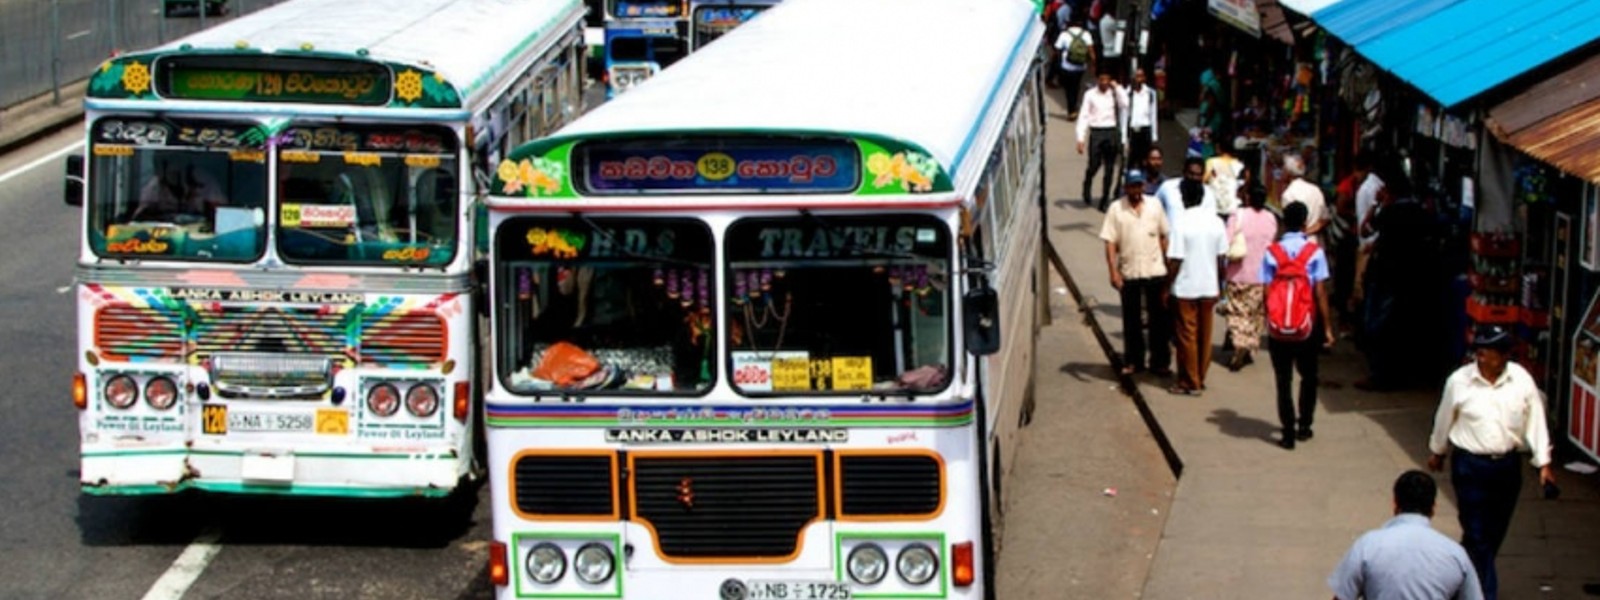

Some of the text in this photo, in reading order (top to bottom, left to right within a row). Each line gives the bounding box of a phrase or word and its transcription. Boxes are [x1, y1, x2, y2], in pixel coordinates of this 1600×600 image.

[256, 73, 282, 95] 120
[703, 158, 730, 174] 138
[738, 155, 836, 182] කොටුව
[759, 227, 914, 257] TRAVELS
[168, 287, 366, 303] LANKA ASHOK LEYLAND
[204, 406, 226, 432] 120
[244, 415, 261, 428] NA
[277, 415, 313, 430] 5258
[144, 422, 185, 433] Leyland
[405, 430, 445, 441] Leyland
[606, 429, 848, 442] LANKA ASHOK LEYLAND
[765, 583, 788, 598] NB
[807, 583, 849, 599] 1725
